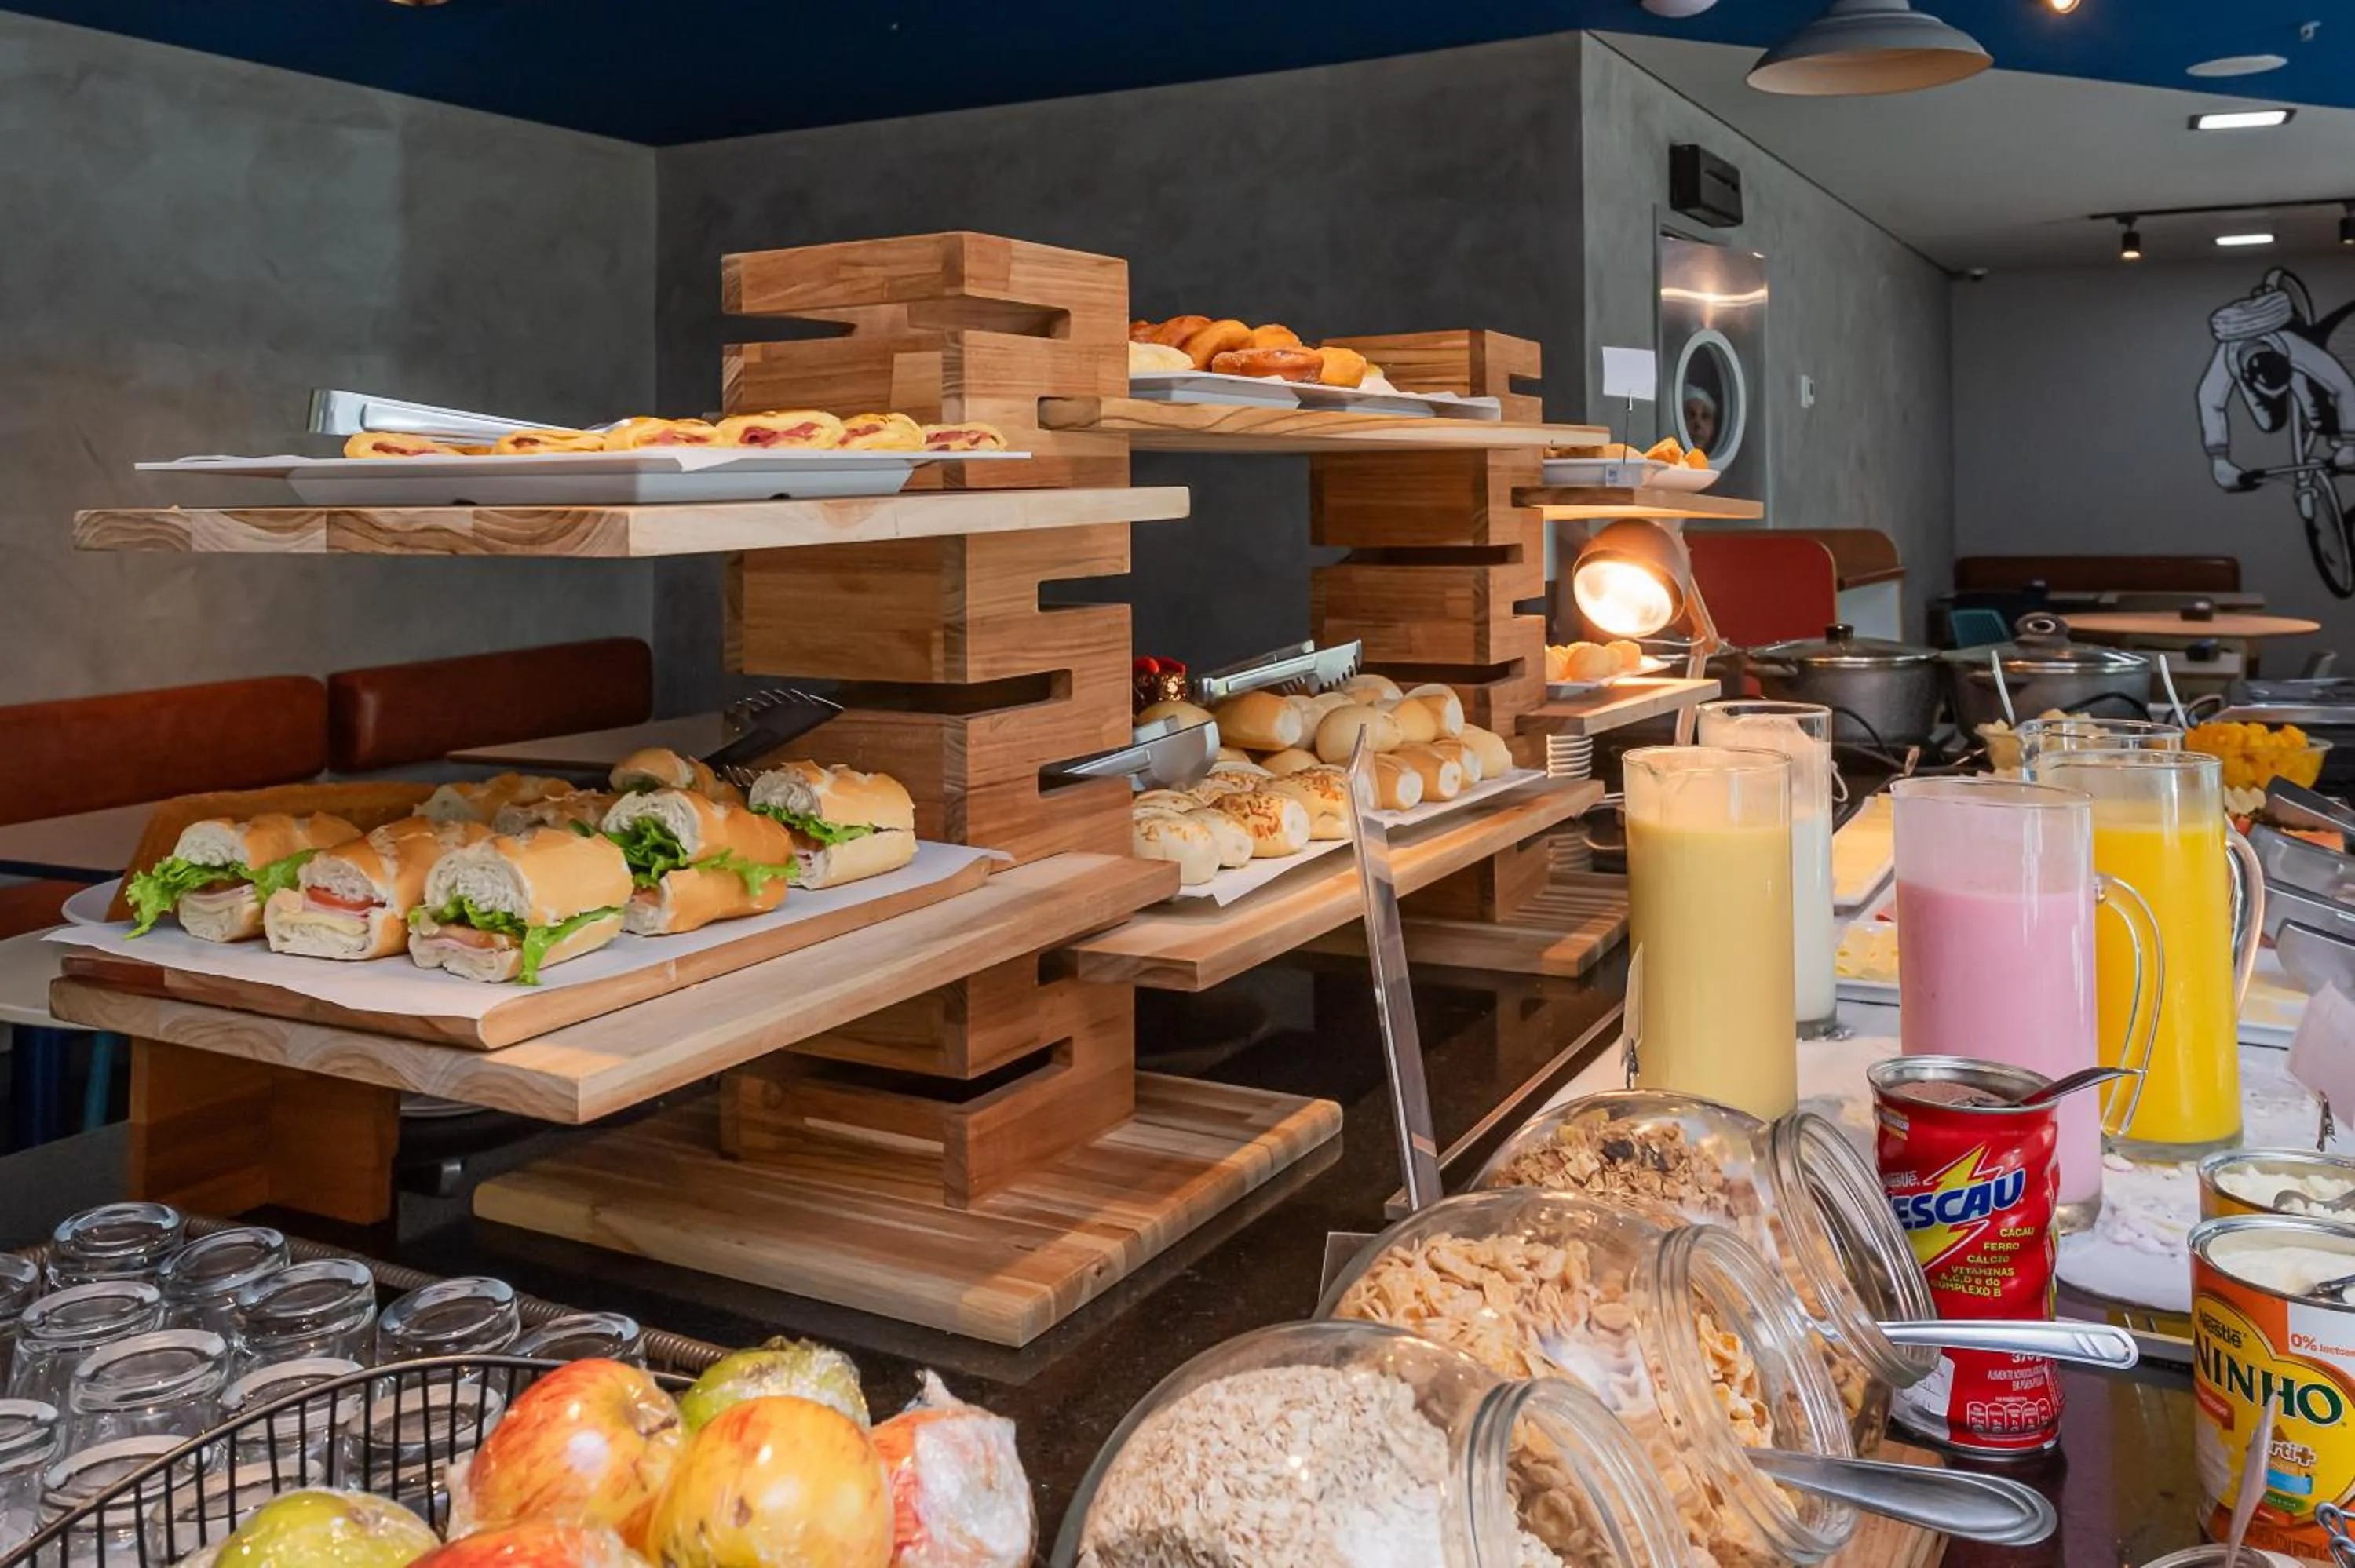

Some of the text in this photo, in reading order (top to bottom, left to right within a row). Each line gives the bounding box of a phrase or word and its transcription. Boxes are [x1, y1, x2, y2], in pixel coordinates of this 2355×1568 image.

[1886, 1168, 2025, 1230] ESCAU
[1999, 1227, 2035, 1238] CACAU
[1984, 1242, 2020, 1252] FERRO
[1951, 1265, 2015, 1277] VITAMINAS
[1985, 1277, 2001, 1287] do
[1993, 1288, 2003, 1297] B
[2200, 1308, 2243, 1349] Nestlé
[2291, 1333, 2317, 1352] 0%
[2195, 1325, 2344, 1427] NINHO
